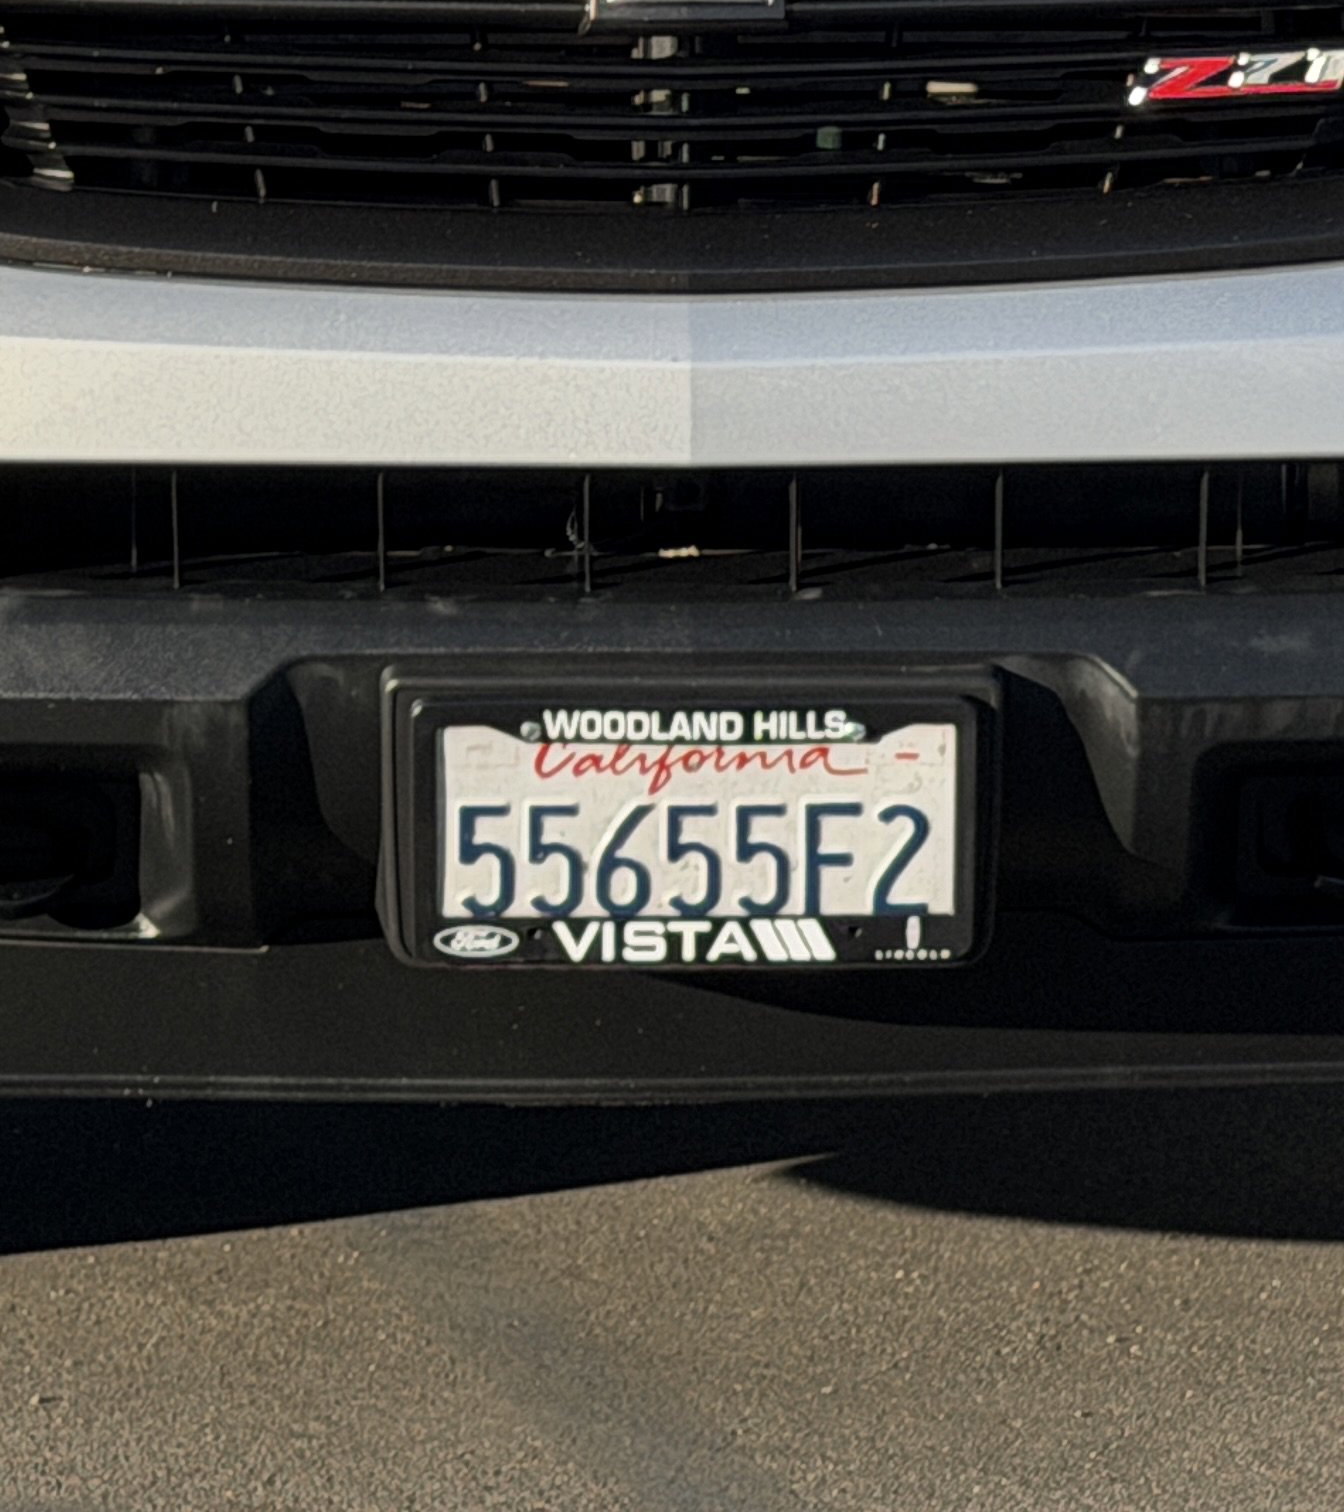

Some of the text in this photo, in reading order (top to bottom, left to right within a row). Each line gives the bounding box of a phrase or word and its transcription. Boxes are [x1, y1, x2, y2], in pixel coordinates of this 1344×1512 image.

[542, 709, 847, 741] WOODLAND HILLS
[534, 742, 869, 796] California
[459, 803, 930, 916] 55655F2
[552, 920, 758, 962] VISTA
